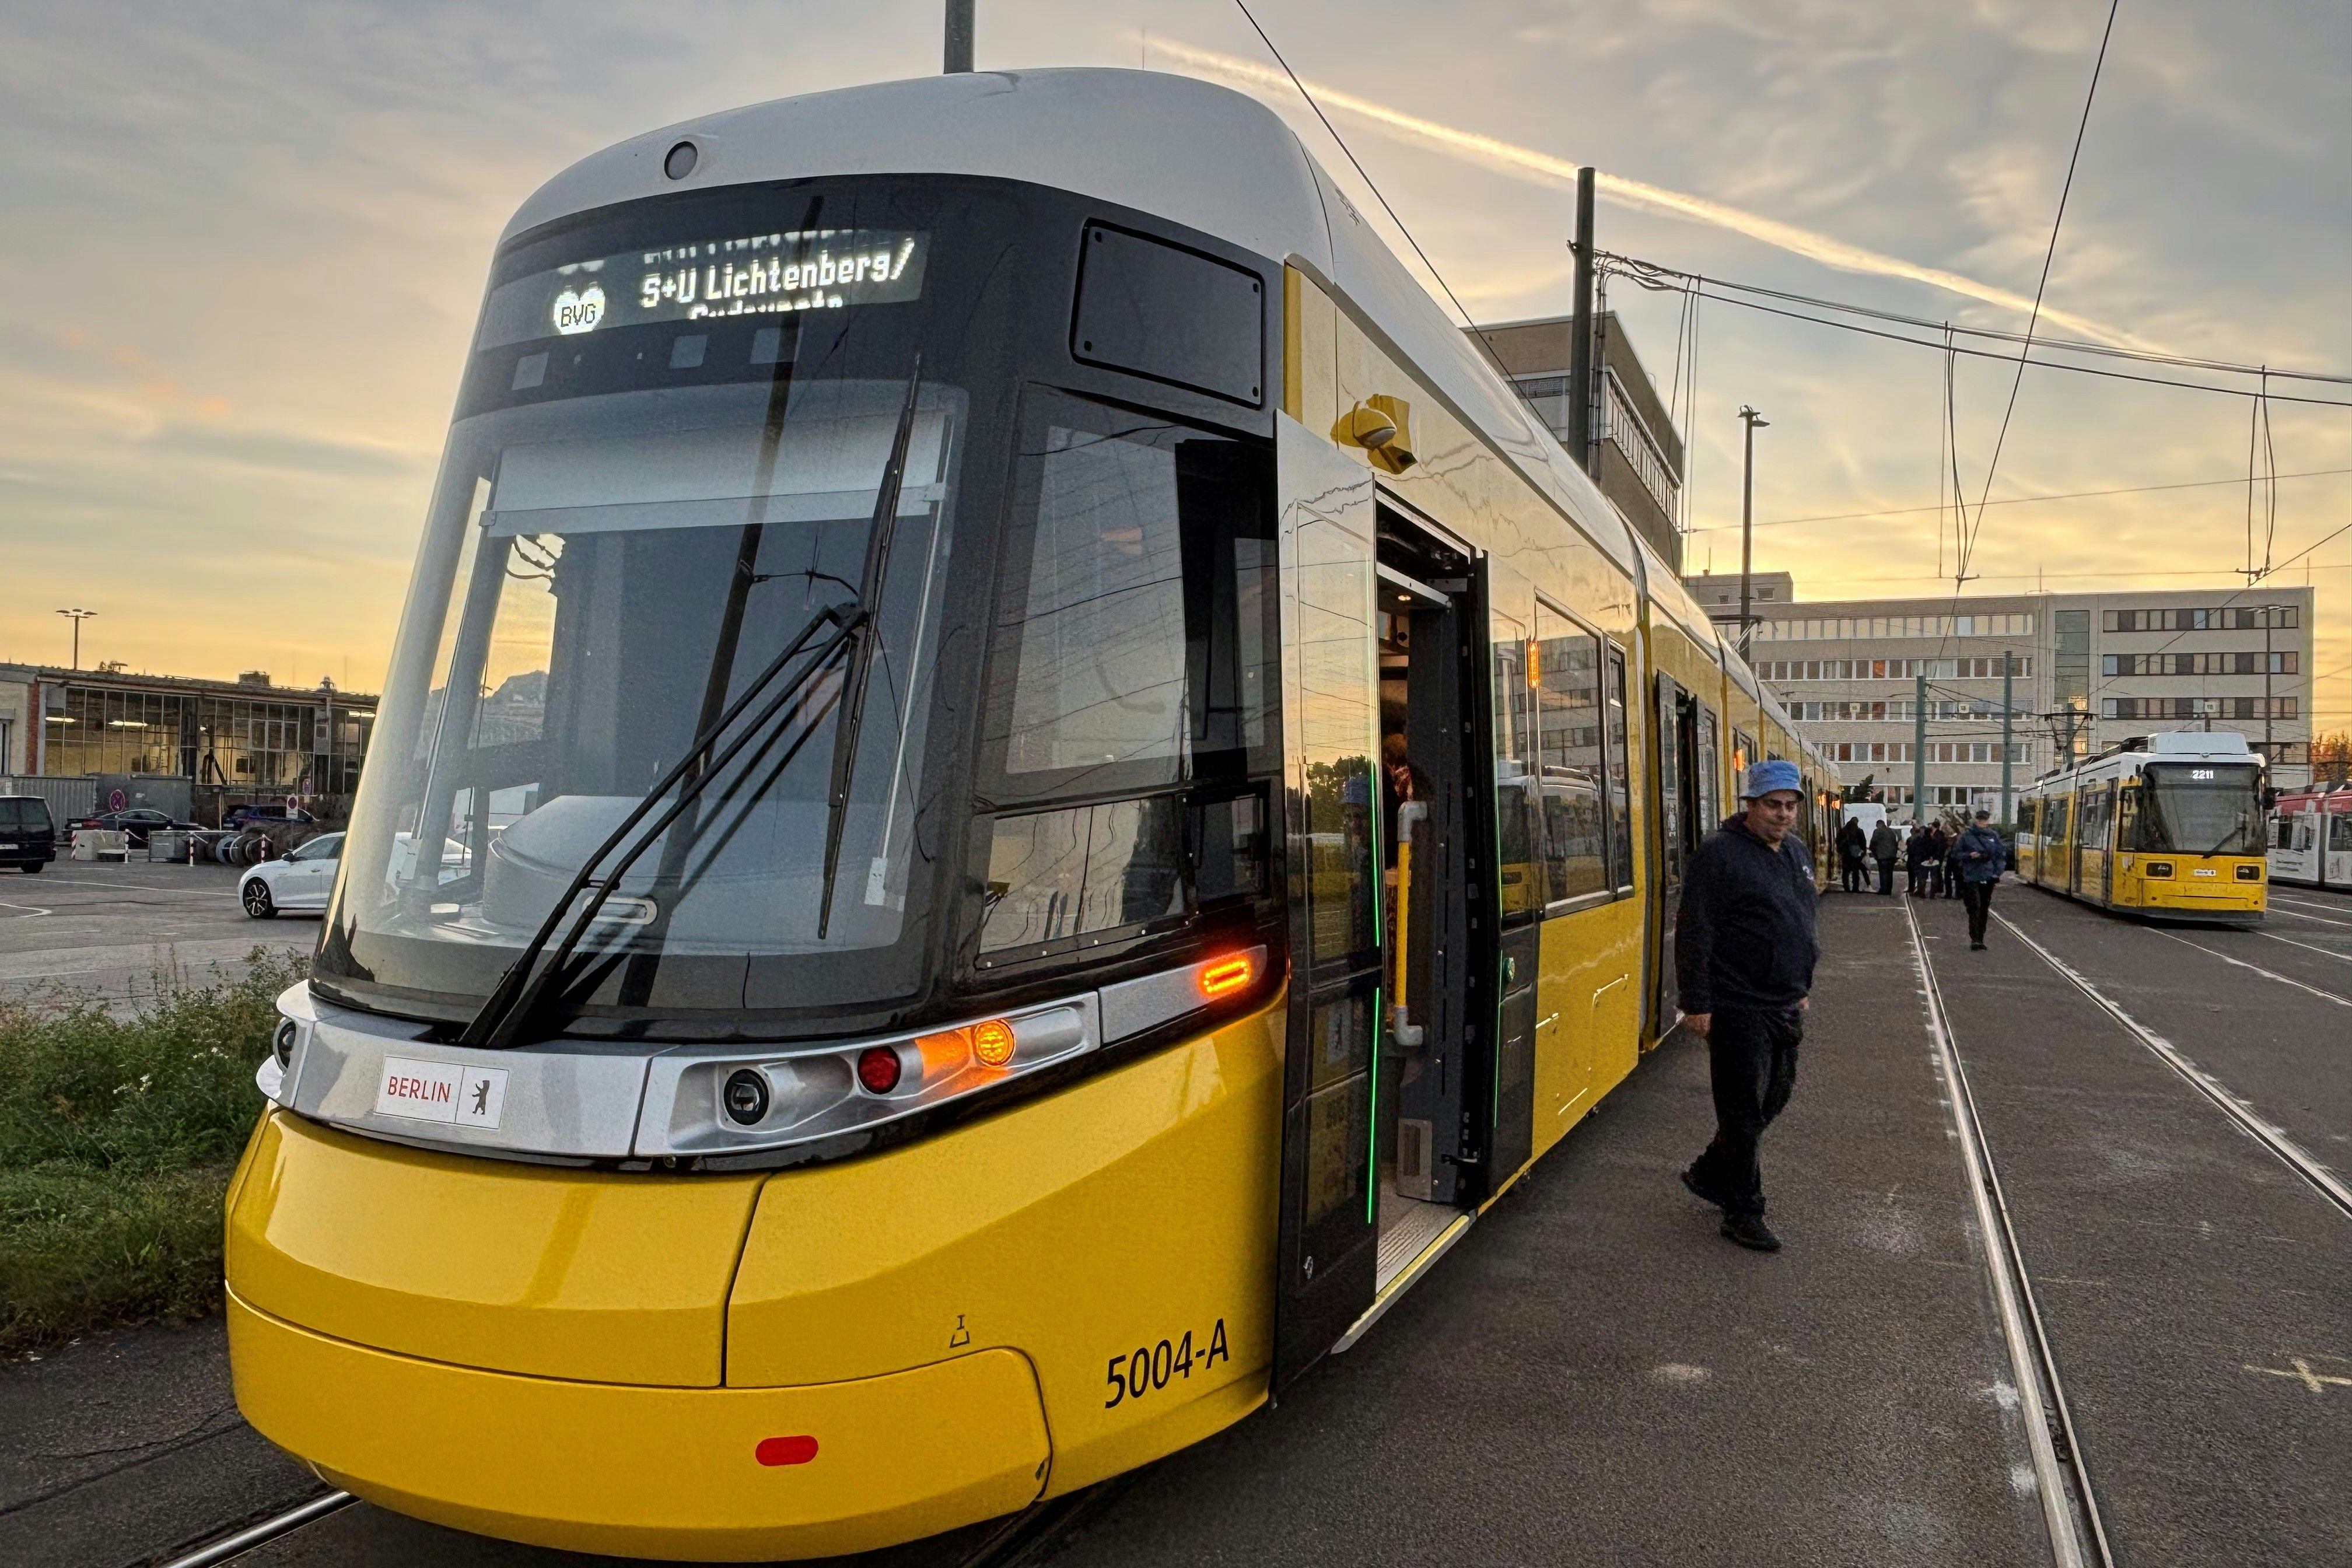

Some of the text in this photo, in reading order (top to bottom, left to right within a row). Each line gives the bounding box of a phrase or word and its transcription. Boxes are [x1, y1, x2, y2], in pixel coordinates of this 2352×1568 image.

[640, 269, 696, 308] S+U
[705, 236, 915, 300] Lichtenberg/
[561, 303, 597, 328] BVG
[2192, 770, 2214, 779] 2211
[387, 1076, 452, 1103] BERLIN
[1104, 1318, 1229, 1409] 5004-A
